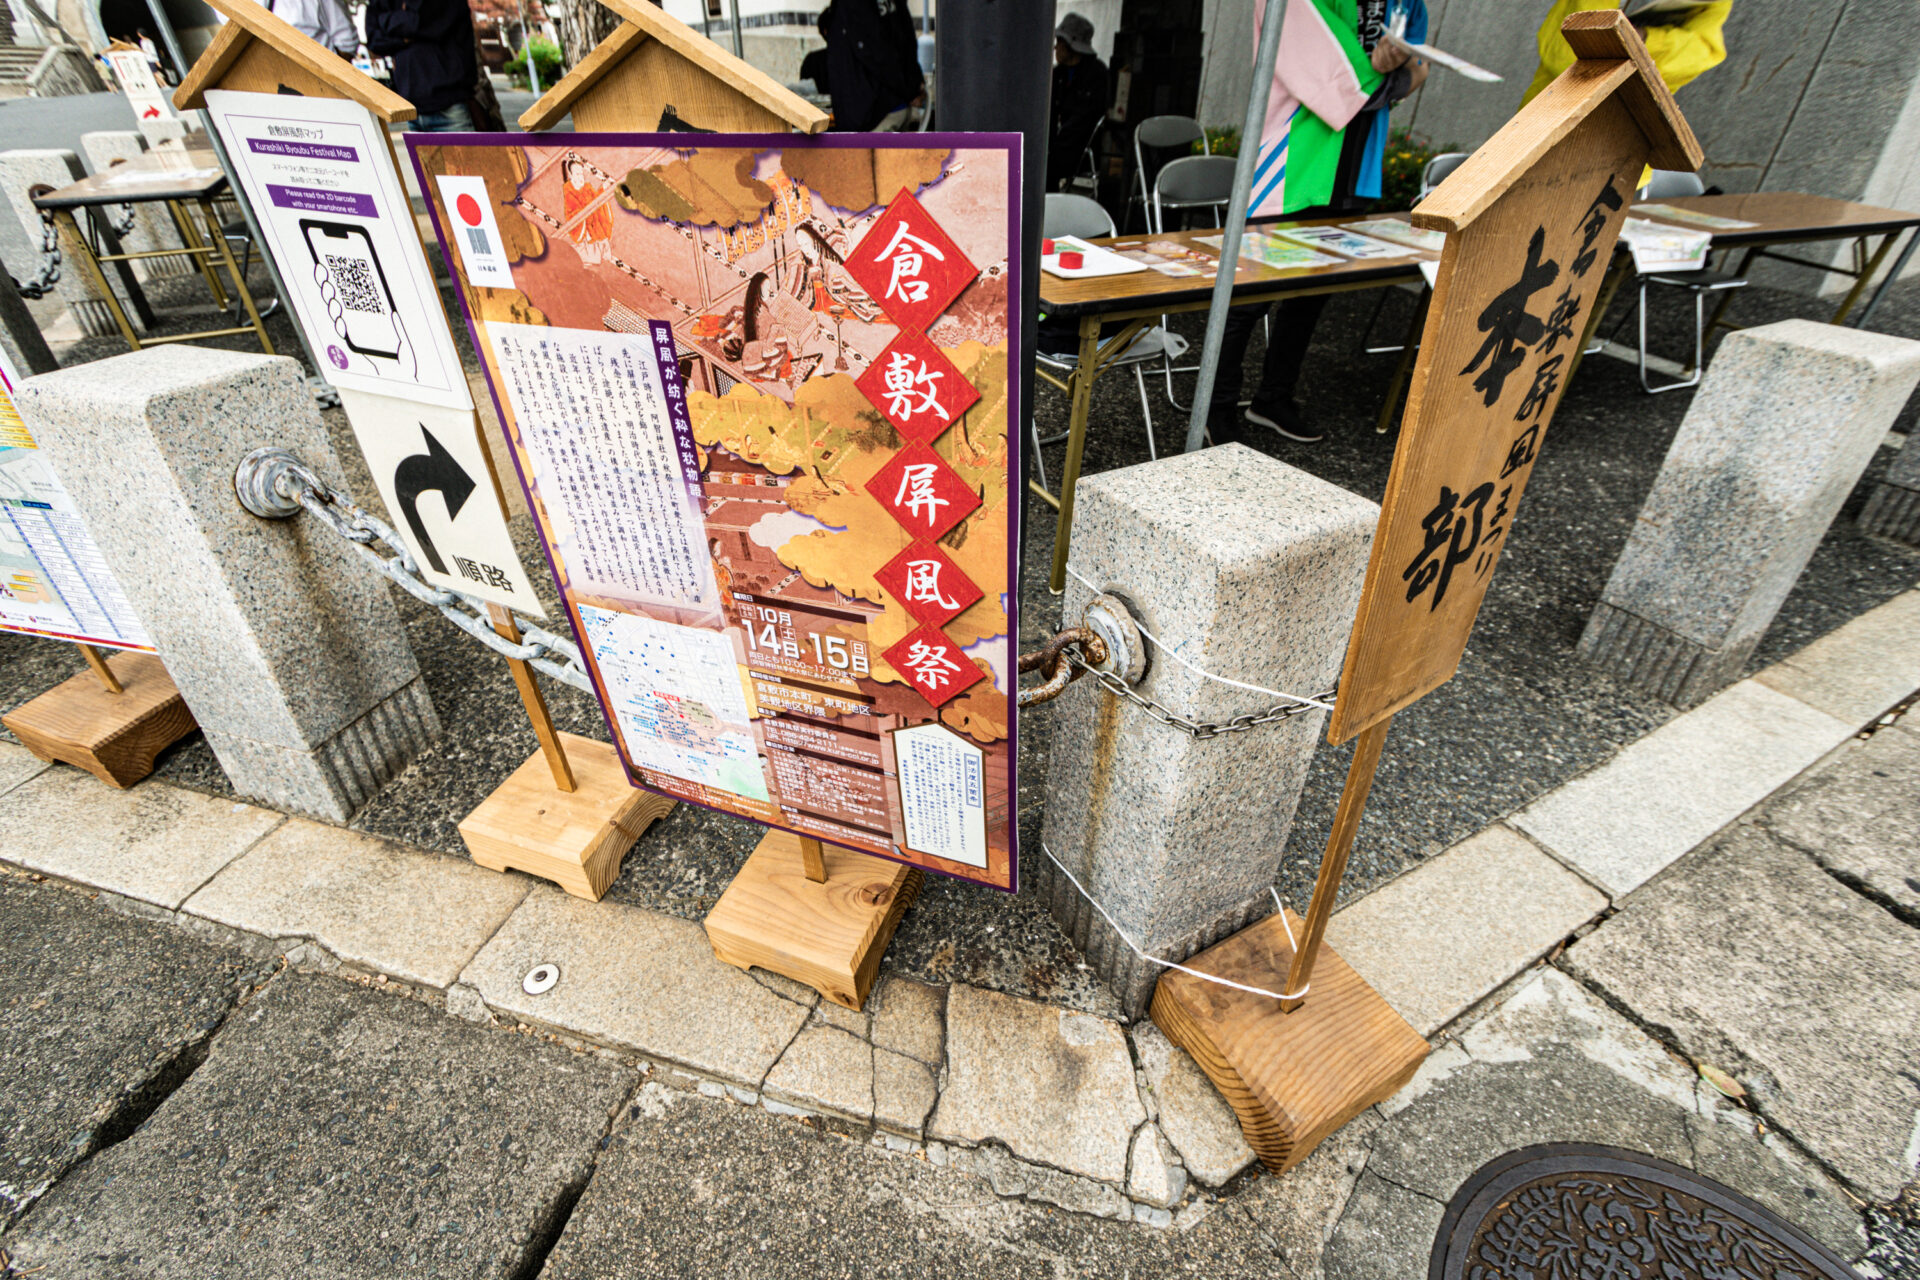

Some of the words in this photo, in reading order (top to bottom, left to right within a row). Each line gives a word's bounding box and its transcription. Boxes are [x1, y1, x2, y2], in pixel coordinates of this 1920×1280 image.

[267, 124, 324, 140] 倉敷屏風祭マップ
[254, 142, 285, 152] Kurashiki
[286, 144, 310, 155] Byoubu
[311, 146, 336, 157] Festival
[337, 149, 352, 159] Map
[285, 188, 303, 198] Please
[303, 190, 316, 200] read
[317, 191, 326, 200] the
[326, 192, 334, 201] 2D
[334, 194, 357, 204] barcode
[292, 200, 304, 208] with
[304, 202, 316, 210] your
[316, 203, 347, 214] smartphone
[655, 327, 703, 497] 屏風が紡ぐ粋な秋物語
[1403, 225, 1559, 613] 本部
[873, 220, 961, 690] 倉敷屏風祭
[452, 554, 515, 594] 順路
[757, 606, 792, 626] 10月
[742, 618, 781, 655] 14
